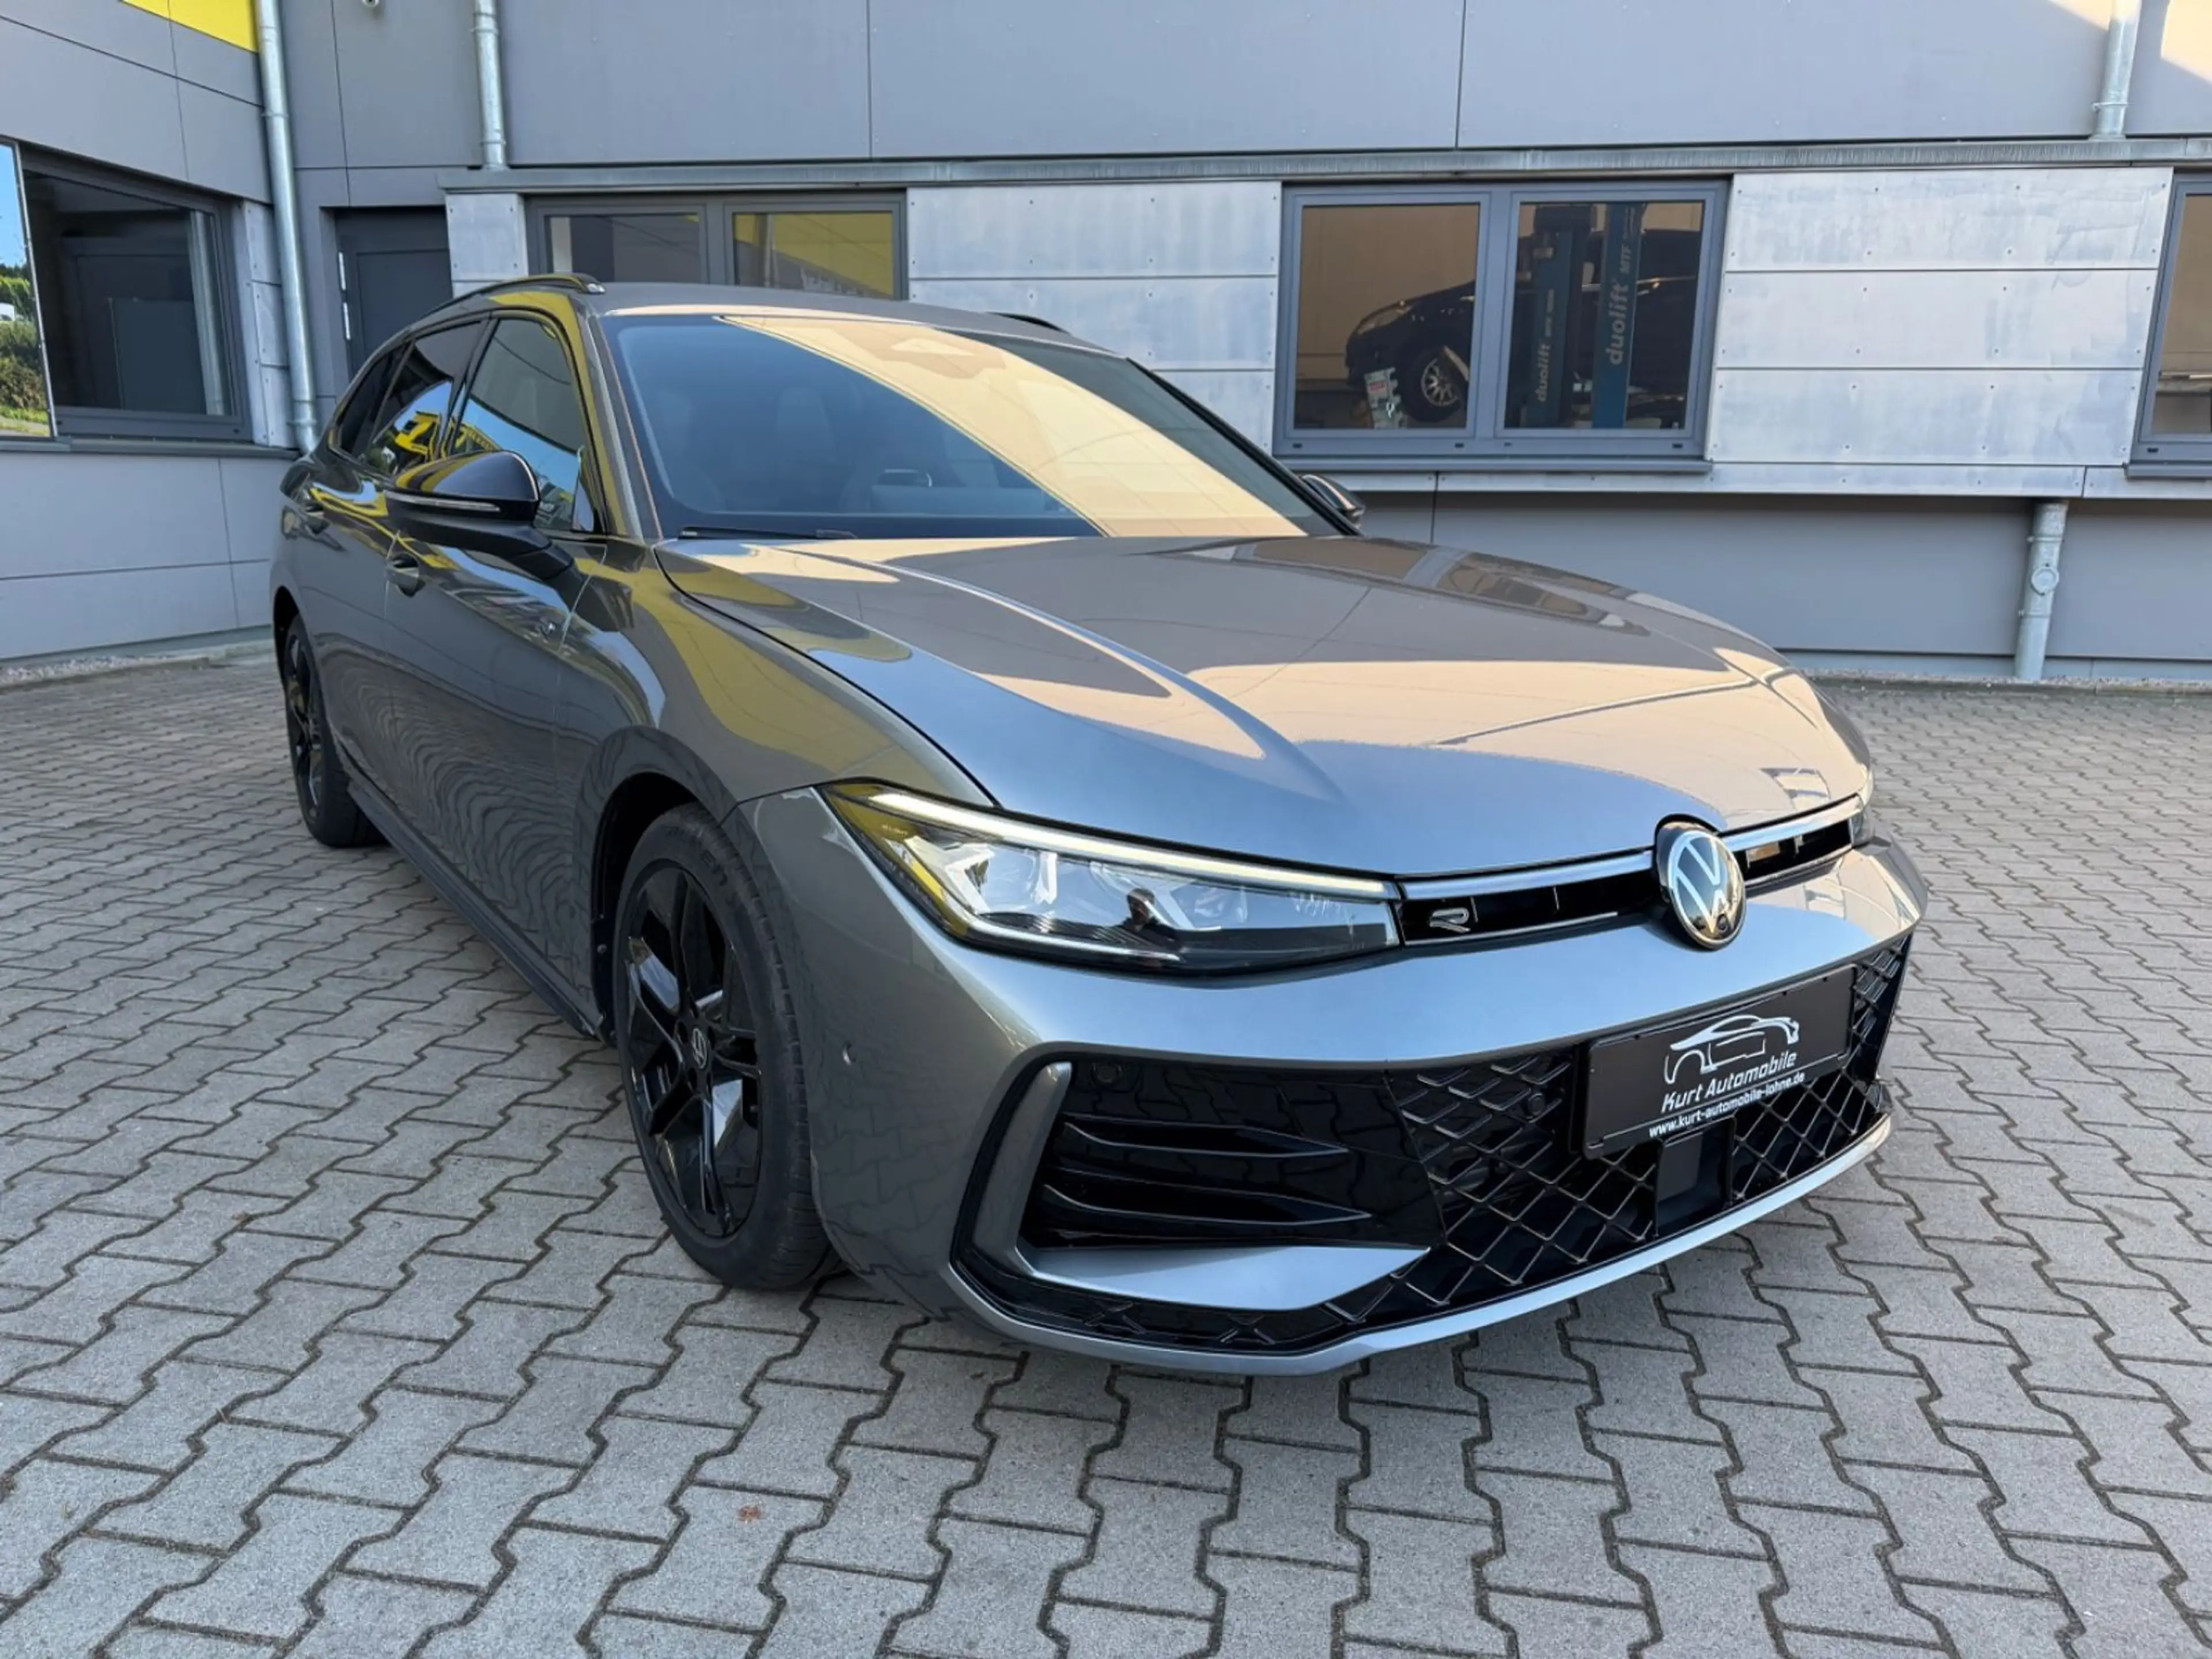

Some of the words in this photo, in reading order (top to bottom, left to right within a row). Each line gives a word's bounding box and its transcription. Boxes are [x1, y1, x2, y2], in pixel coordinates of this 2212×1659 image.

[1605, 282, 1629, 365] duolift
[1649, 1072, 1805, 1138] www.kurt-automobile-lohne.de
[1661, 1084, 1703, 1113] Kurt
[1704, 1051, 1797, 1099] Automobile
